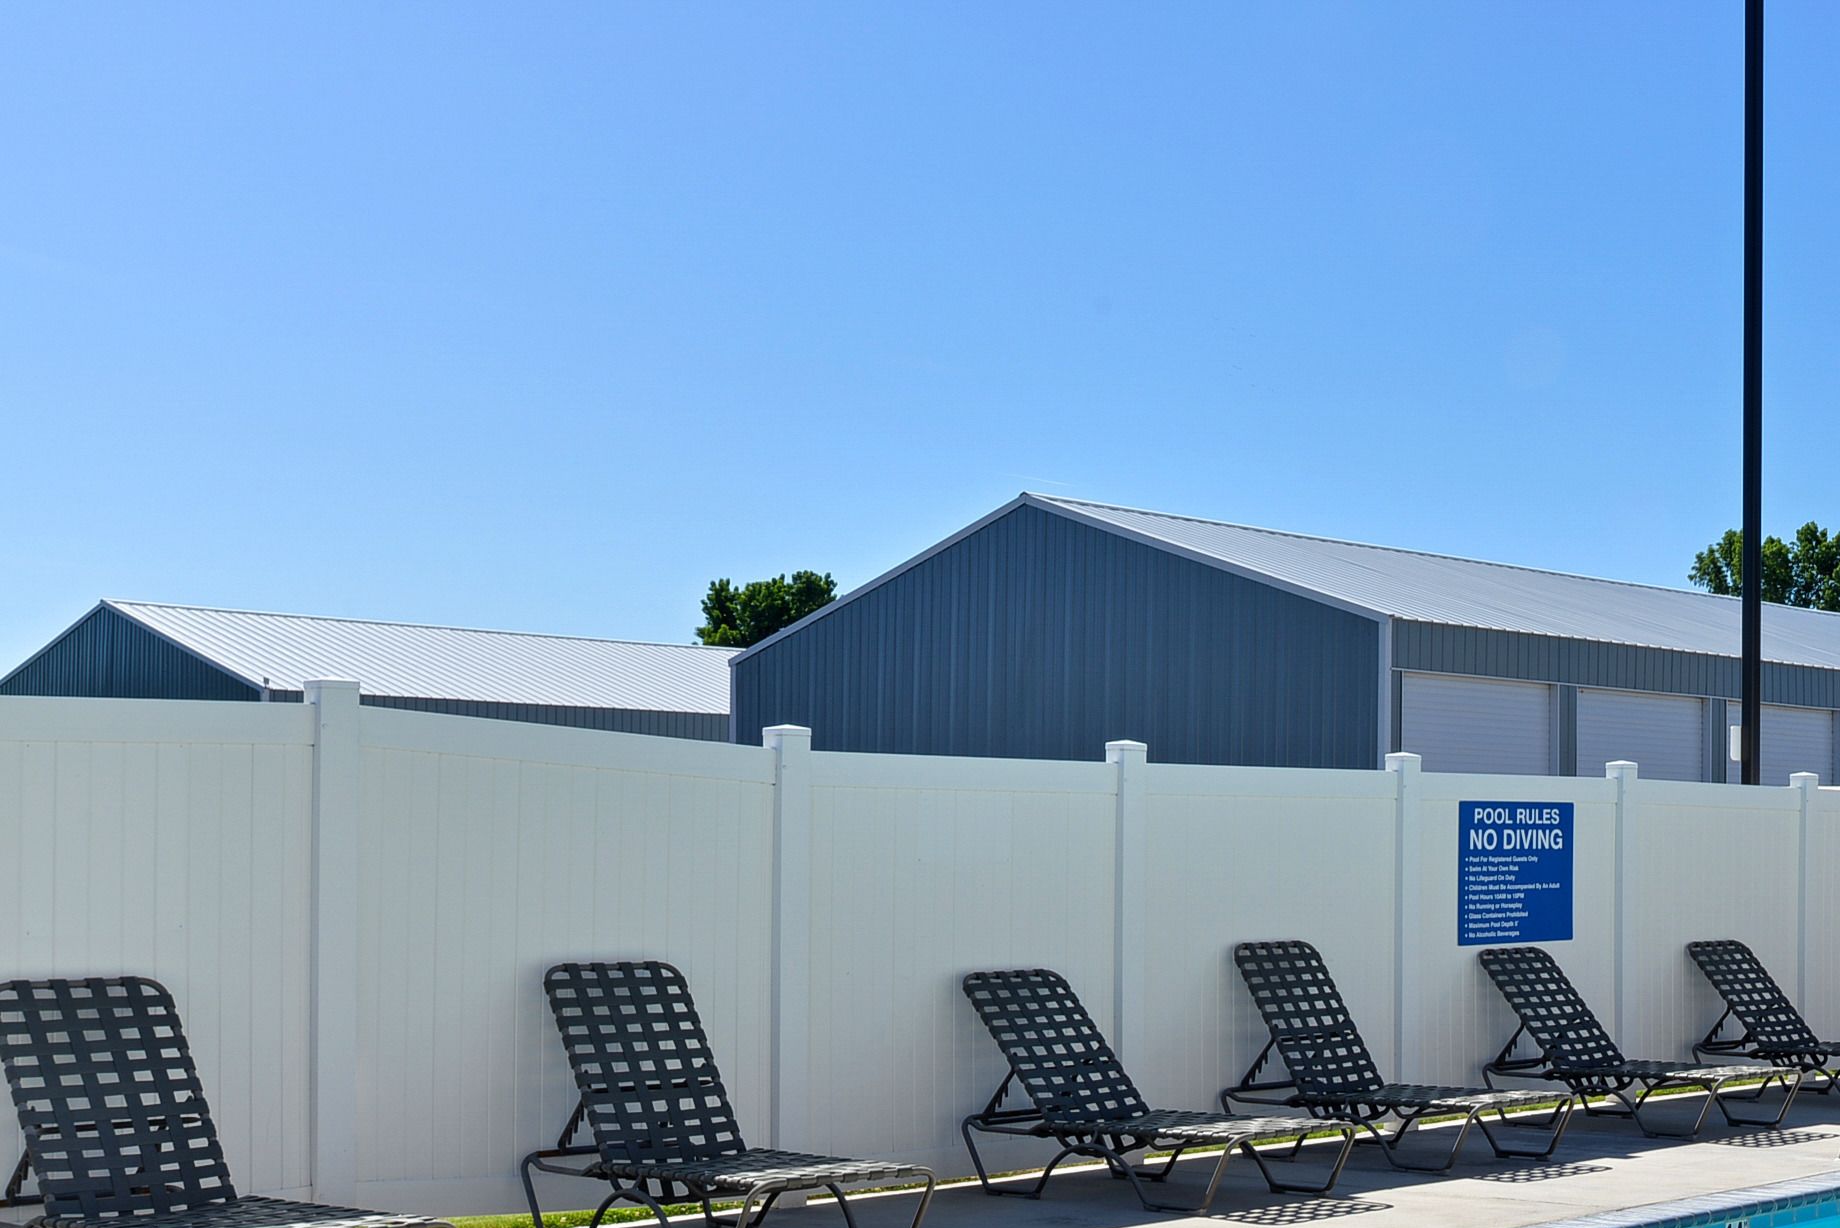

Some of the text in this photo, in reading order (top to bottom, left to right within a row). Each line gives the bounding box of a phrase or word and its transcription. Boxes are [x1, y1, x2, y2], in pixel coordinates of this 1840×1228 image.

[1474, 807, 1560, 825] POOL RULES
[1469, 828, 1563, 851] NO DIVING
[1528, 855, 1538, 863] Only
